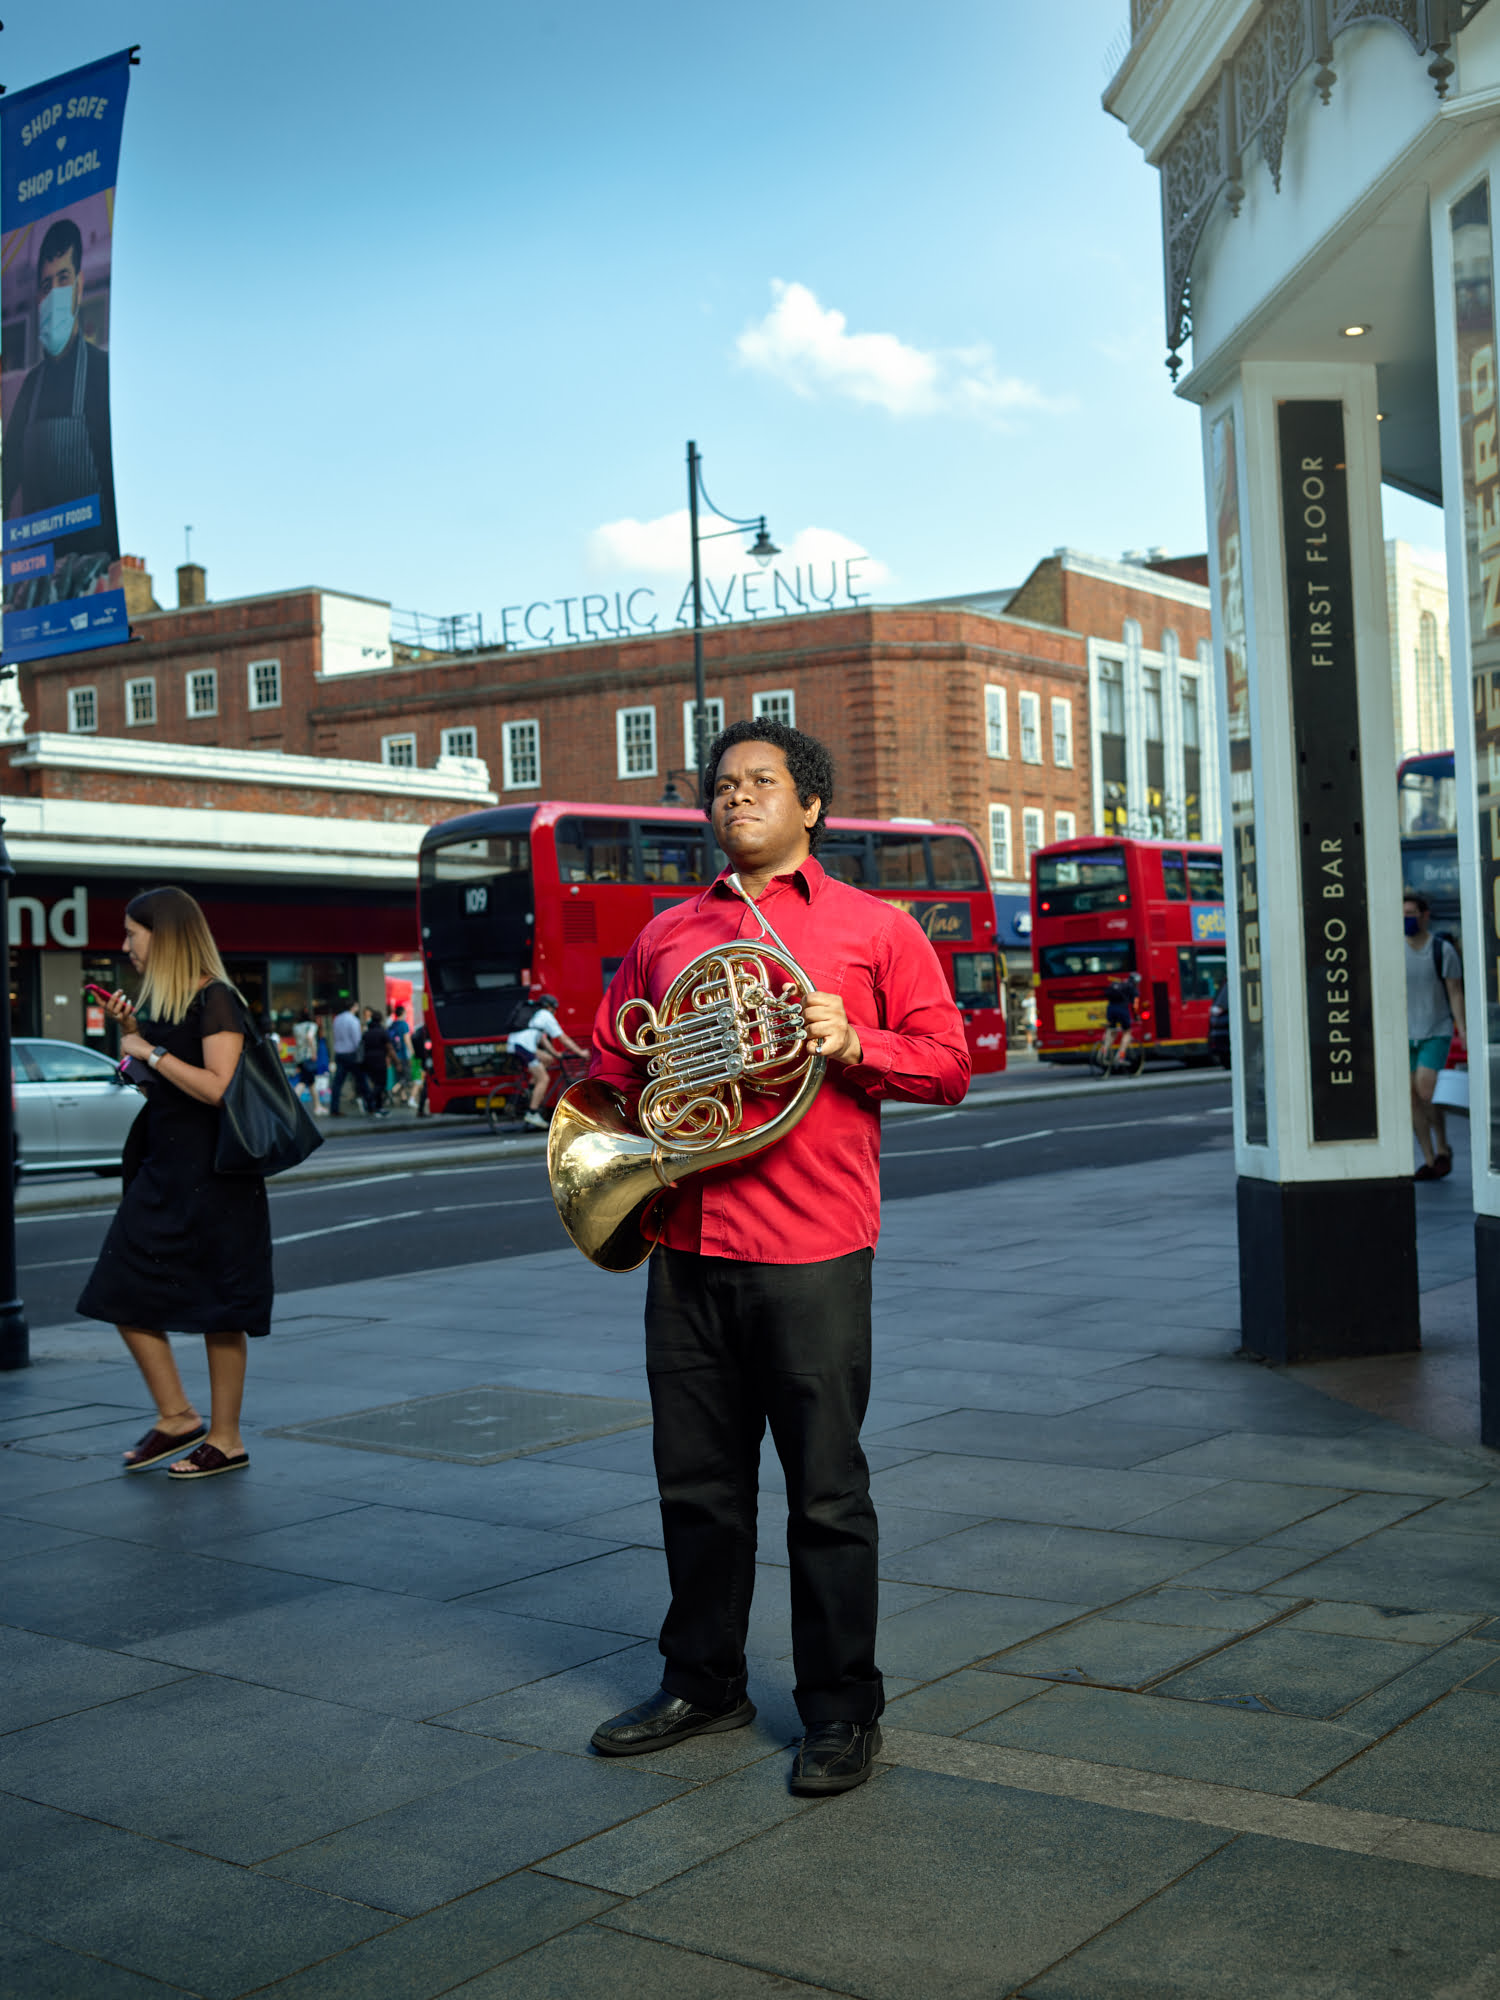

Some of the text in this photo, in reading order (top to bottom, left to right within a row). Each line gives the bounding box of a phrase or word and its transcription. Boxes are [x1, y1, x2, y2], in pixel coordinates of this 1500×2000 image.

[21, 96, 108, 147] SHOP SAFE
[18, 149, 101, 202] SHOP LOCAL
[31, 514, 64, 536] QUALITY
[65, 505, 93, 526] FOODS
[11, 554, 46, 577] BRIXTON
[1301, 456, 1334, 667] FIRST FLOOR
[675, 556, 872, 628] AVENUE
[465, 887, 488, 913] 109
[1320, 838, 1353, 1084] ESPRESSO BAR
